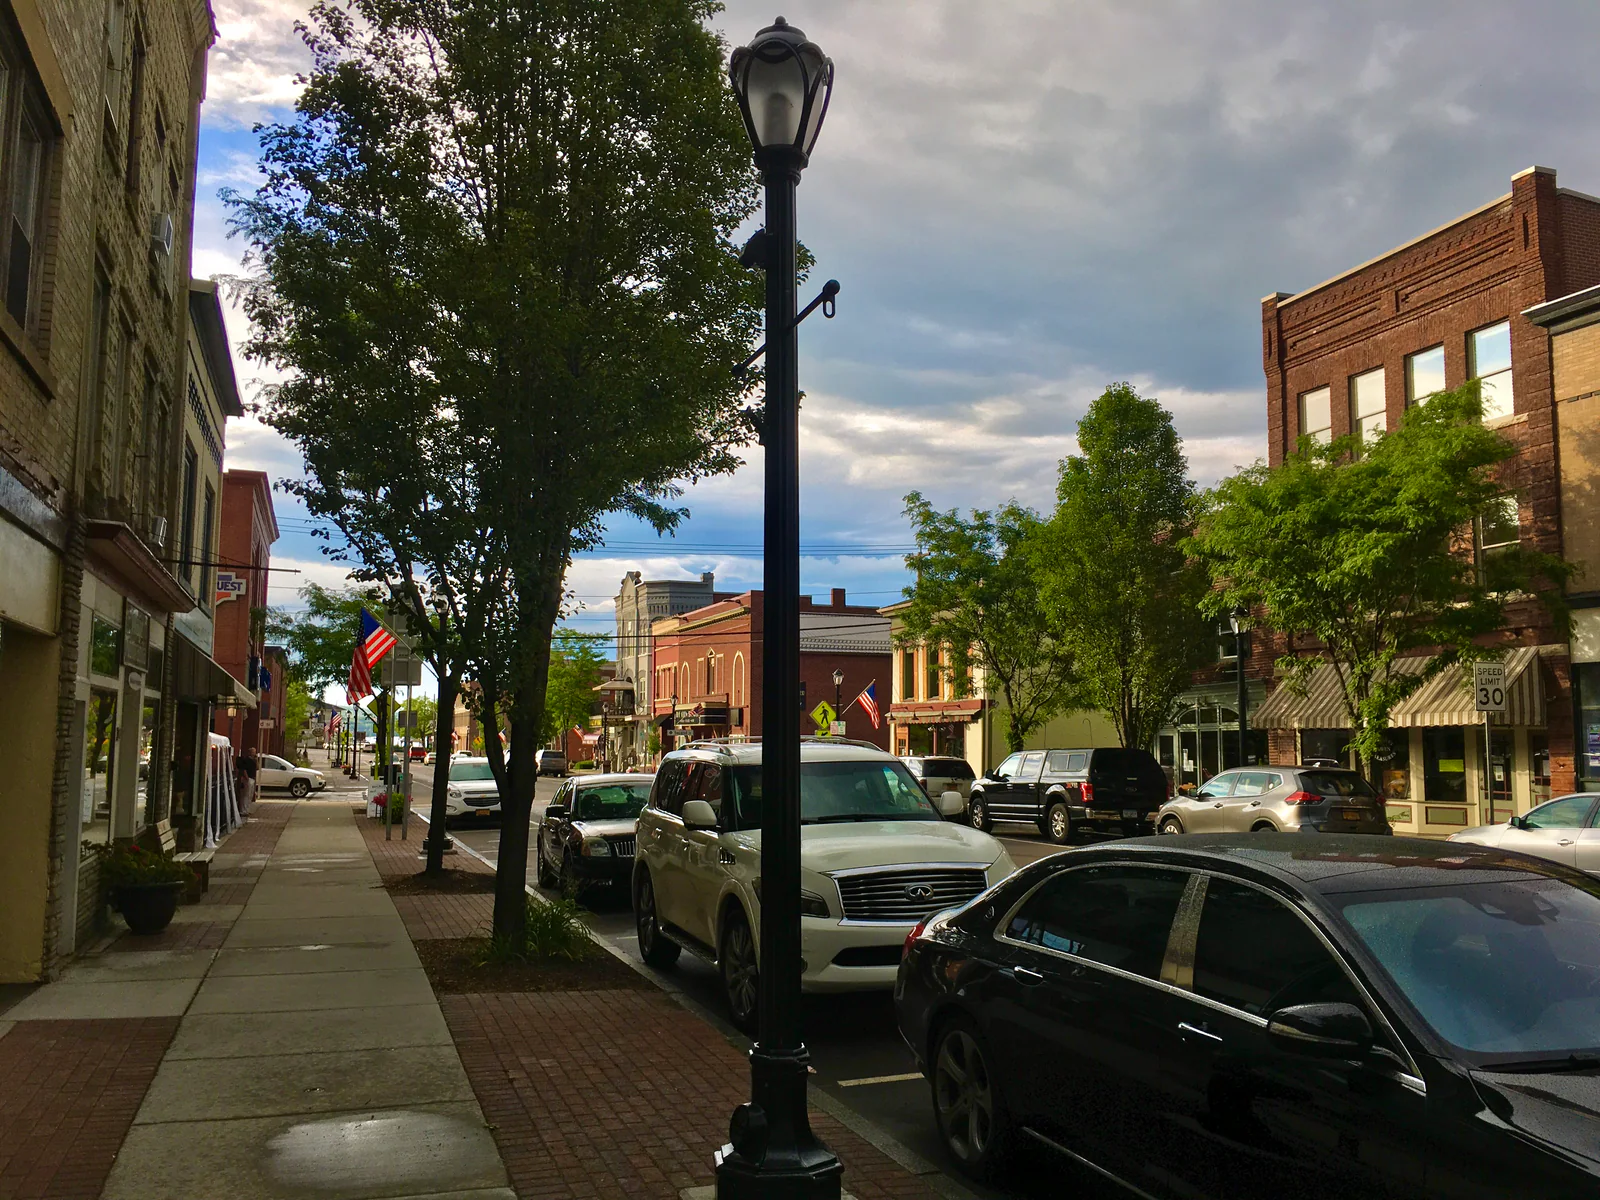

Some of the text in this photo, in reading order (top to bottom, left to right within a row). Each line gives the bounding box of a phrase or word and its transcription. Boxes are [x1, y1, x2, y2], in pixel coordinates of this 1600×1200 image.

[216, 581, 243, 592] UEST
[1477, 667, 1503, 676] SPEED
[1480, 677, 1501, 686] LIMIT
[1479, 687, 1504, 706] 30
